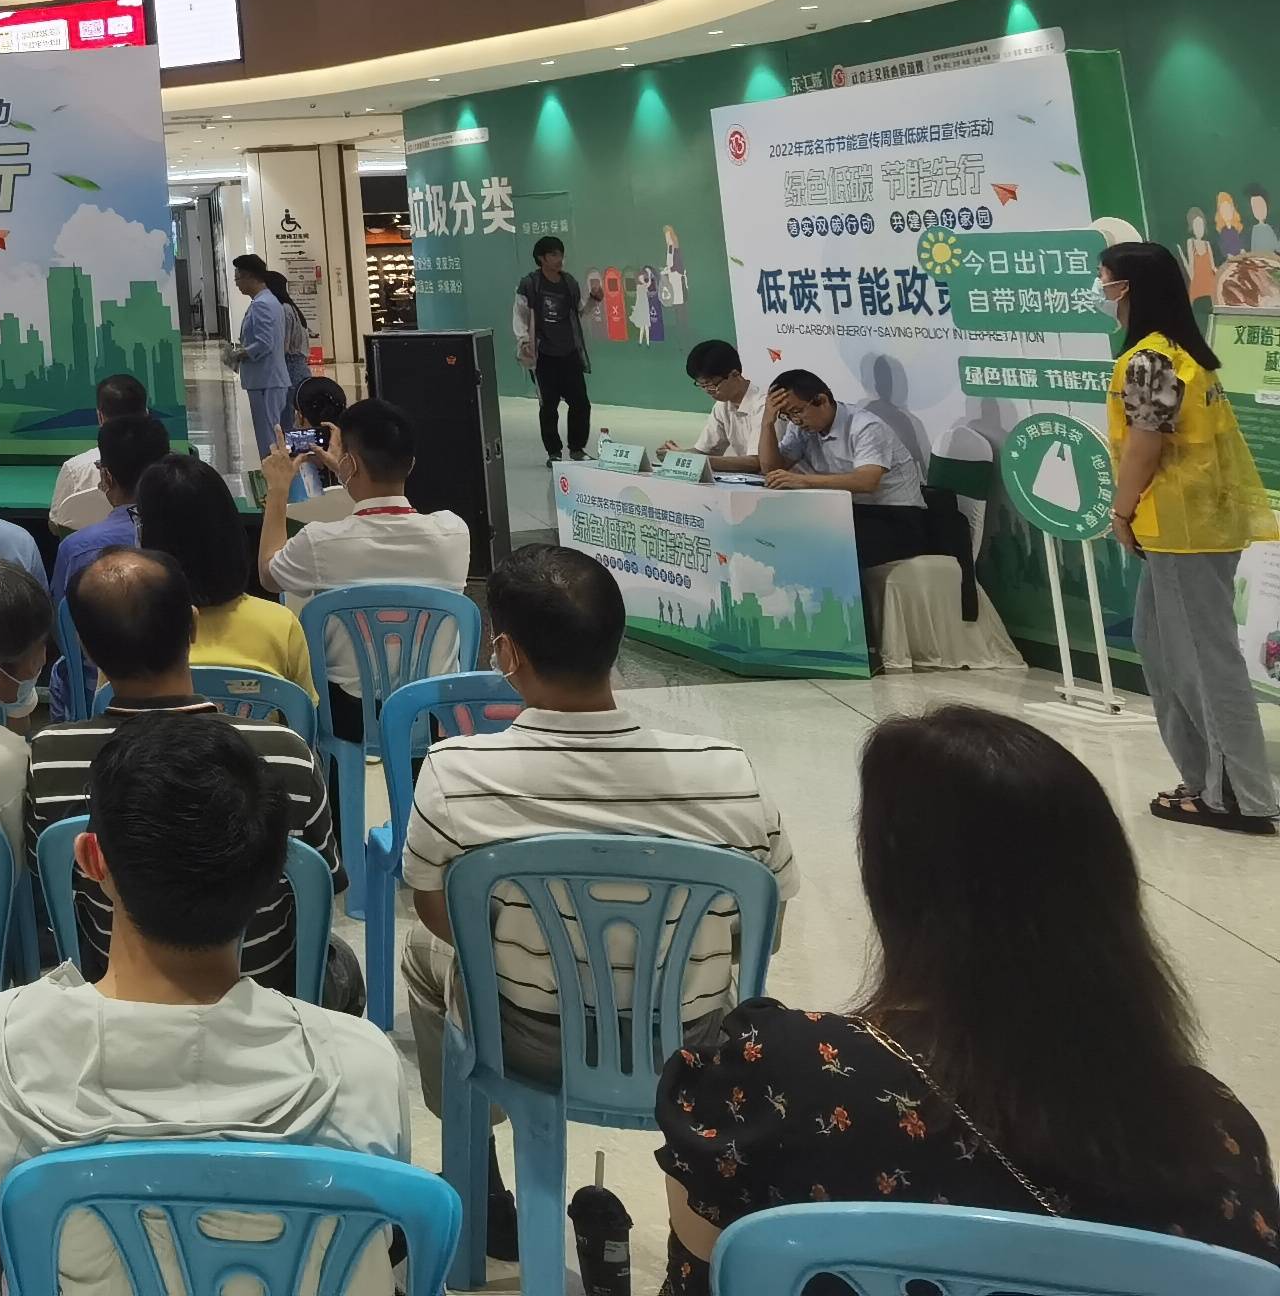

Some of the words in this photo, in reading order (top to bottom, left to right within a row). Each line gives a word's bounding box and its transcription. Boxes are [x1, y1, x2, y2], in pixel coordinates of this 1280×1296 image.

[769, 117, 994, 159] 2022年茂名市节能宣传周暨低碳日宣传活动
[783, 163, 874, 207] 绿色低碳
[881, 153, 985, 201] 节能先行
[408, 176, 516, 238] 垃圾分类
[891, 206, 993, 234] 共建美好家园
[962, 247, 1092, 276] 今日出门宜
[968, 288, 1098, 315] 自带购物袋
[776, 323, 835, 336] LOW-CARBON
[837, 325, 913, 339] ENERGY-SAVING
[915, 327, 950, 340] POLICY
[964, 366, 1038, 388] 绿色低碳
[572, 509, 637, 555] 绿色低碳
[640, 524, 712, 574] 节能先行
